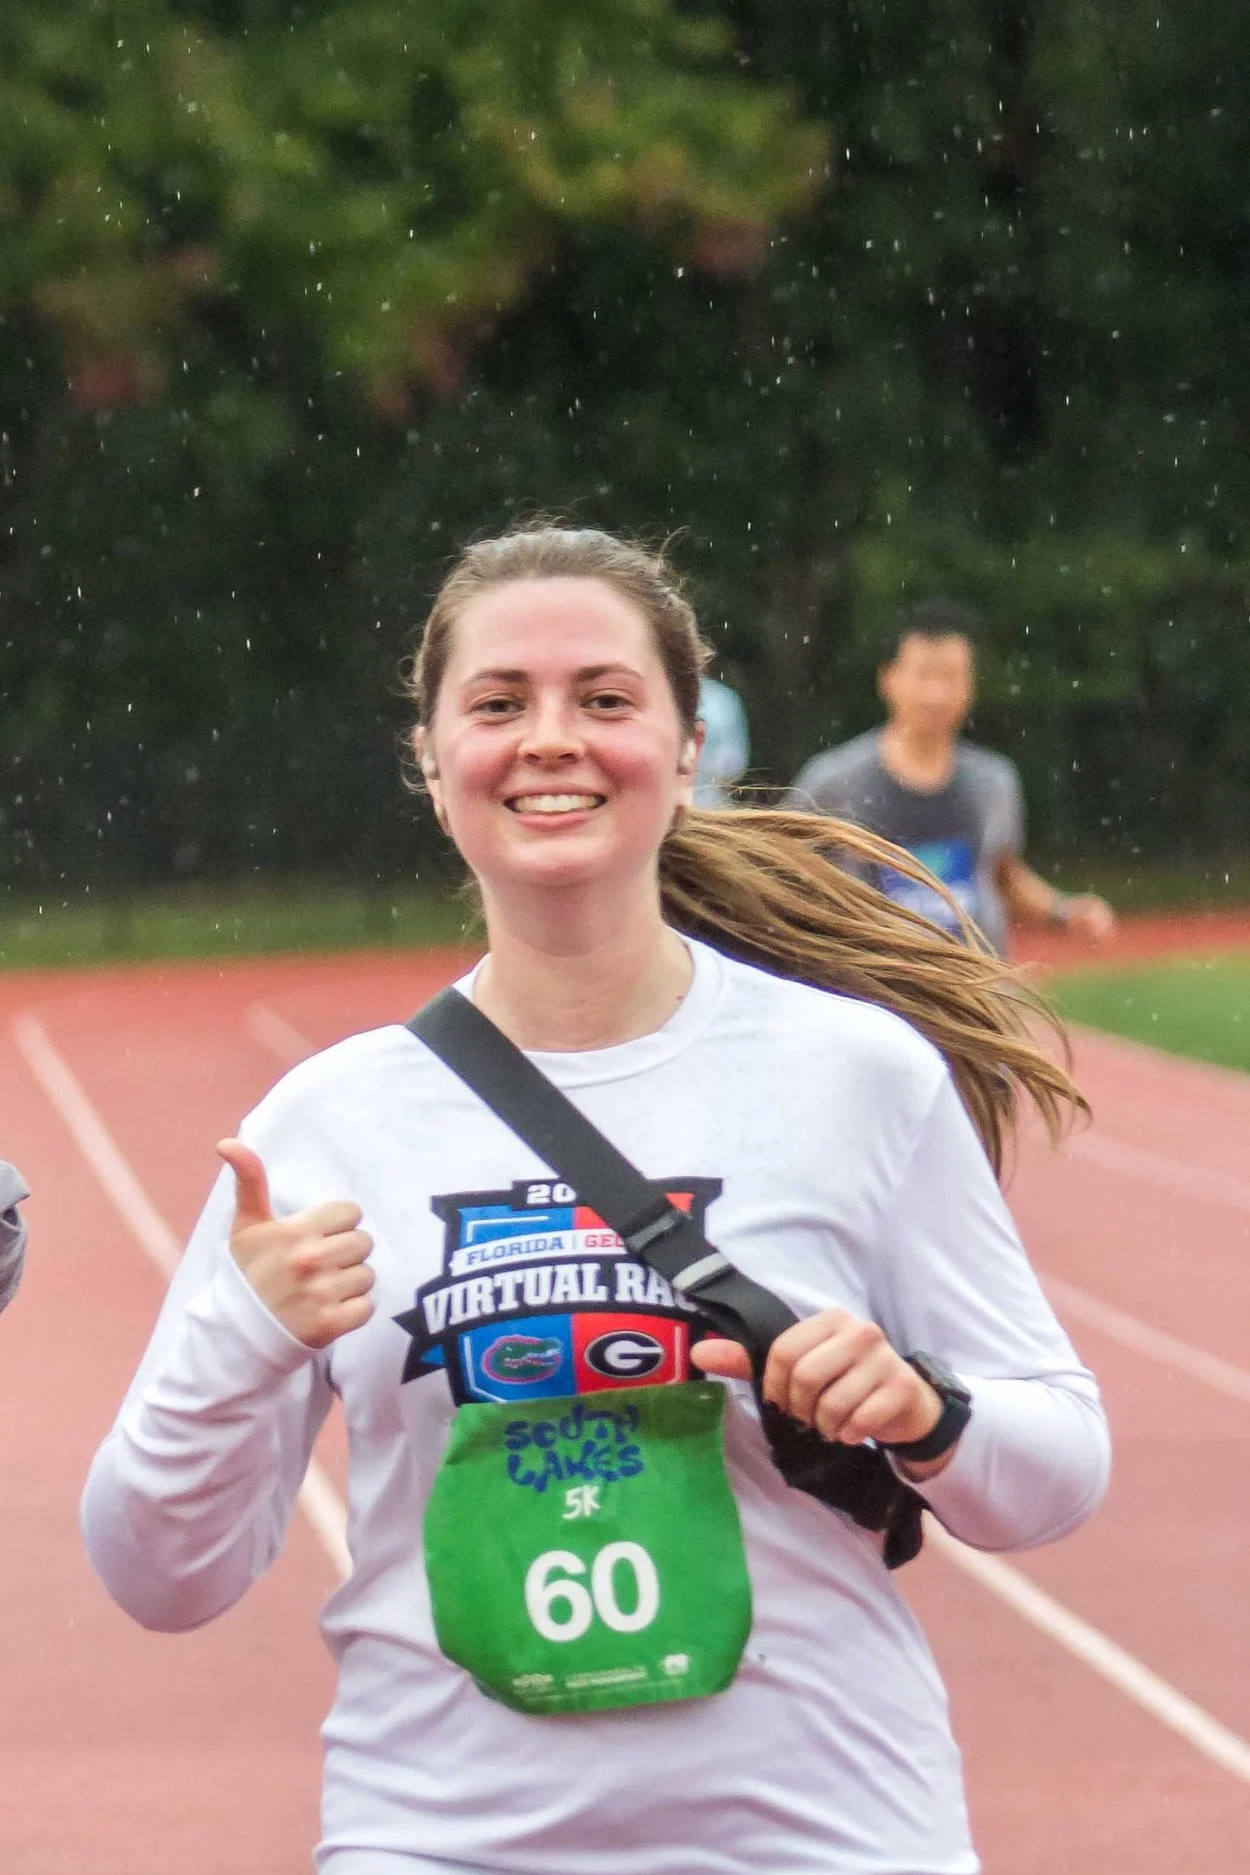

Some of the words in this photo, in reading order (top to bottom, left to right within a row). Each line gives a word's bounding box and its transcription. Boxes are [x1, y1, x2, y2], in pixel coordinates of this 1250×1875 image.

[465, 1237, 564, 1266] FLORIDA
[423, 1263, 607, 1335] VIRTUAL
[604, 1340, 662, 1369] G
[505, 1403, 639, 1450] SOUTH
[507, 1440, 643, 1492] LAKES
[562, 1484, 601, 1519] 5K
[525, 1541, 659, 1643] 60
